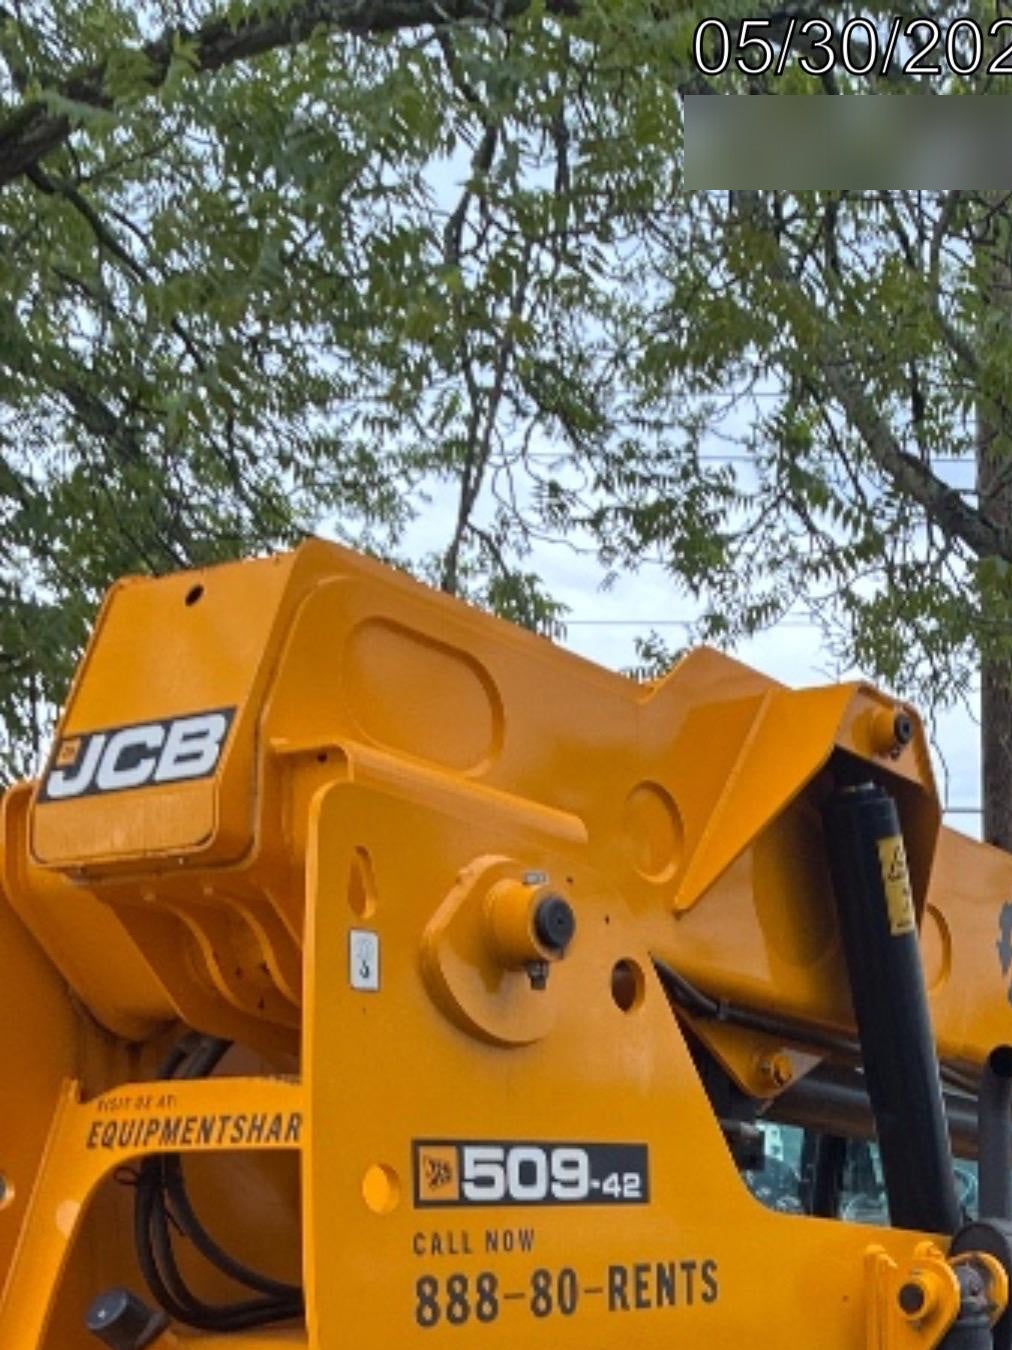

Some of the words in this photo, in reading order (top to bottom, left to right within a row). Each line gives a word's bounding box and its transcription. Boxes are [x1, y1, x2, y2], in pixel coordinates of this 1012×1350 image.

[47, 712, 227, 799] JCB
[413, 1232, 473, 1256] CALL
[485, 1228, 534, 1253] NOW
[415, 1259, 719, 1328] 888-80-RENTS
